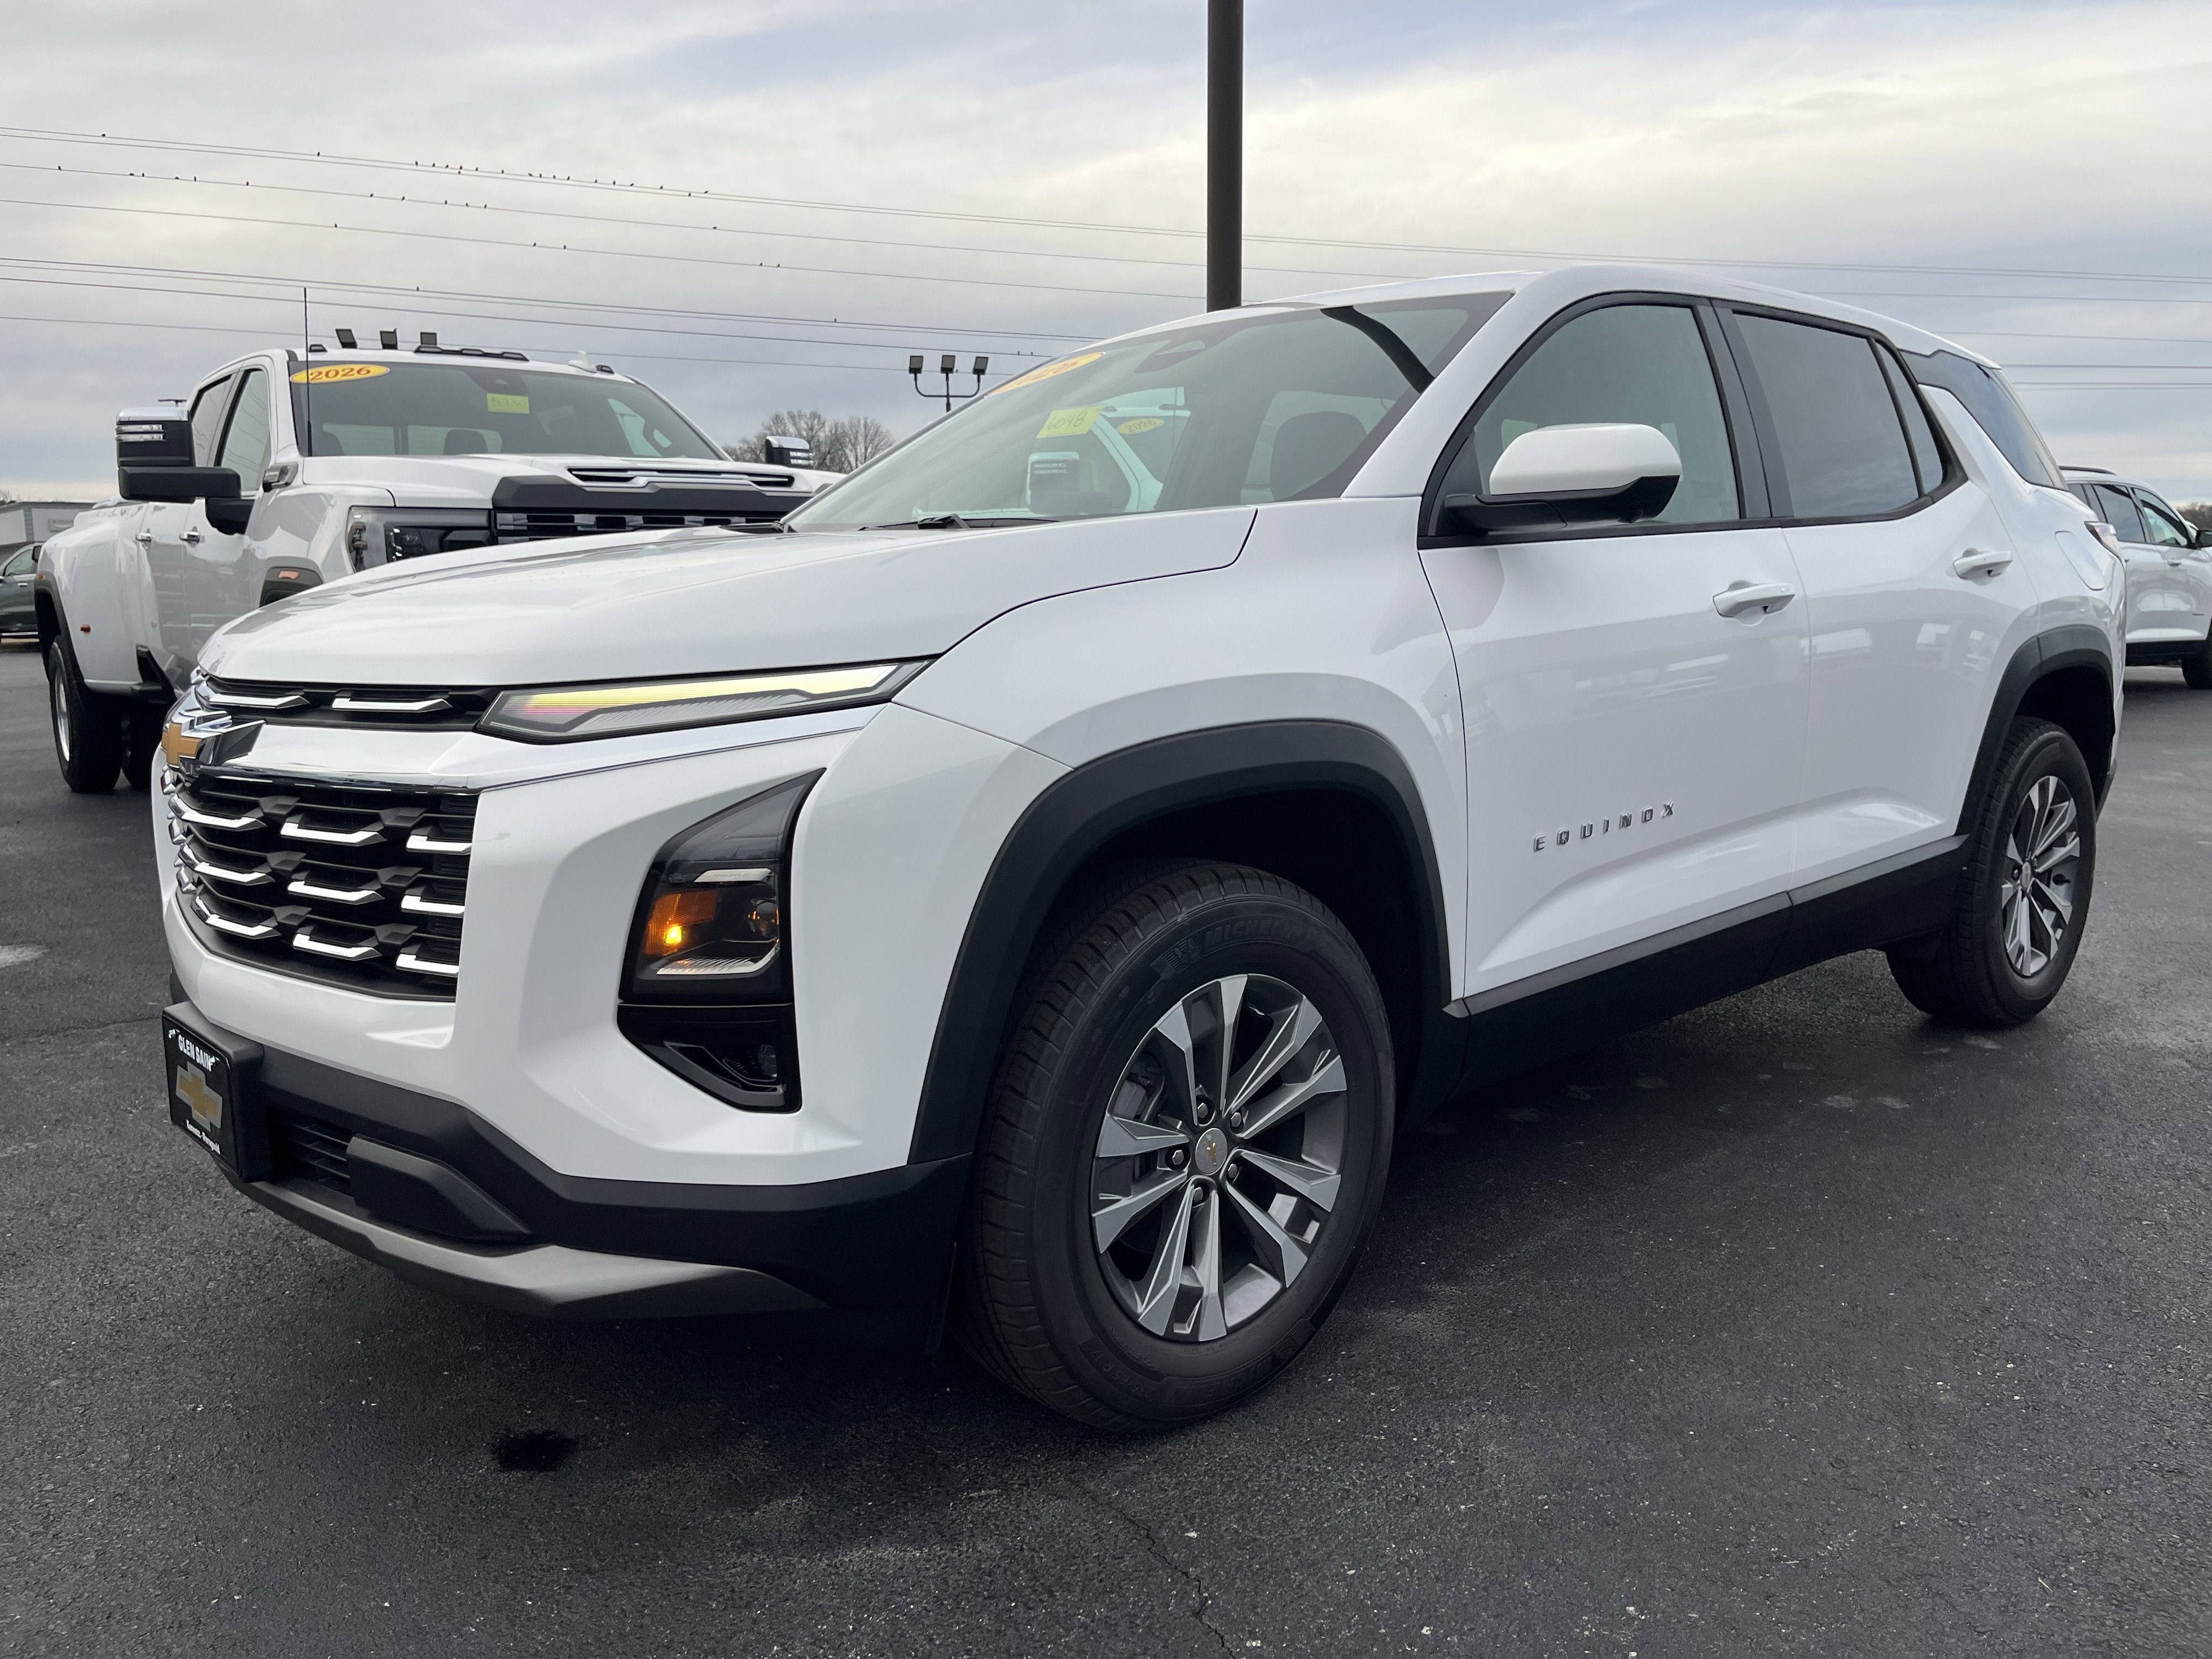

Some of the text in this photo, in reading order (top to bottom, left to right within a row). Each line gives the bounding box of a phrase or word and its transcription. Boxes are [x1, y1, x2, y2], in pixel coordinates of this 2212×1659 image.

[309, 366, 371, 381] 2026
[1125, 419, 1156, 433] 2026
[1533, 802, 1674, 851] EQUINOX
[1205, 918, 1304, 948] MICHELIN
[178, 1034, 195, 1060] GLEN
